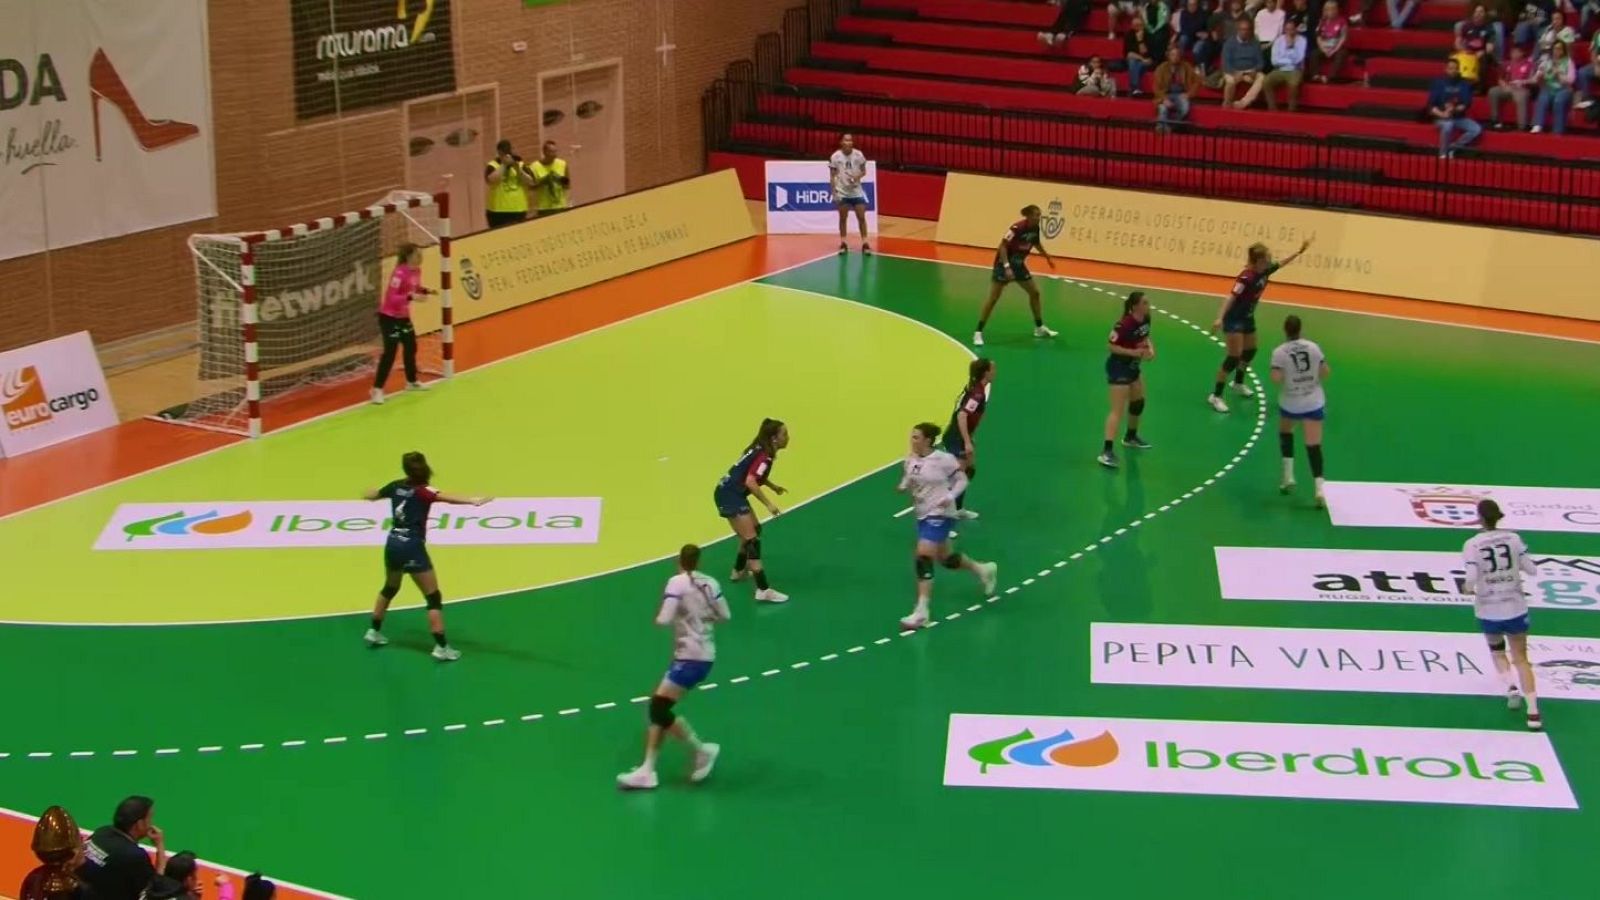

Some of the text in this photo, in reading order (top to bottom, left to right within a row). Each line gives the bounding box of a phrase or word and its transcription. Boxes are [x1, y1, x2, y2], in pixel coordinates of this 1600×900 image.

[1069, 226, 1098, 243] REAL
[1073, 204, 1141, 225] OPERADOR
[1221, 220, 1271, 240] OFICIAL
[1279, 226, 1296, 242] DE
[1289, 351, 1311, 372] 13
[1480, 544, 1513, 572] 33
[1103, 640, 1484, 676] PEPITA VIAJERA
[1145, 740, 1545, 784] Iberdrola
